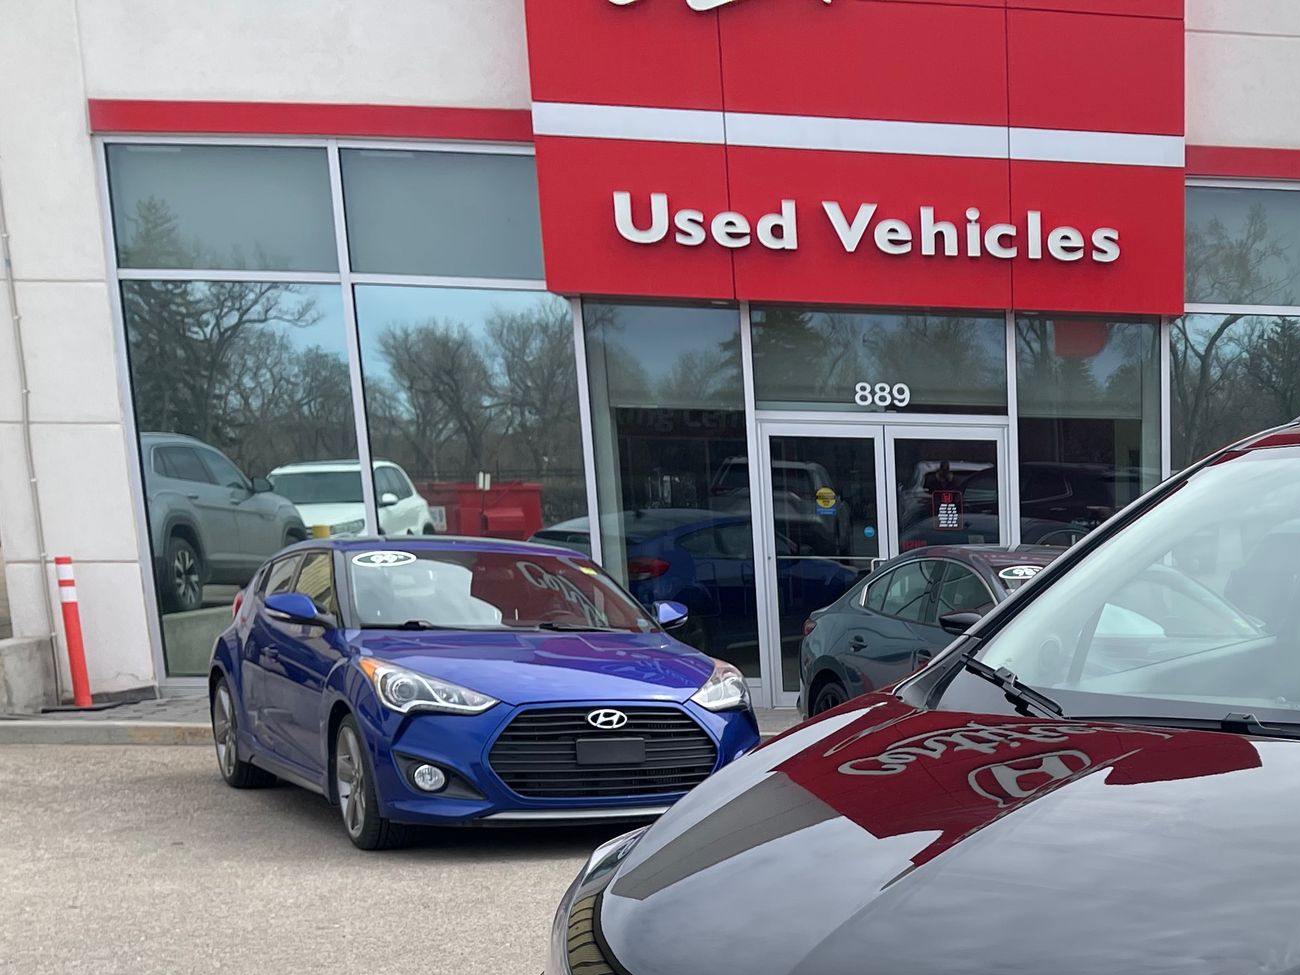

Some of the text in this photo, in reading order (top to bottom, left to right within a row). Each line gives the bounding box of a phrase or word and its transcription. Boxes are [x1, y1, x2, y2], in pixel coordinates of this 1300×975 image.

[613, 191, 1120, 262] Used Vehicles
[854, 382, 911, 407] 889
